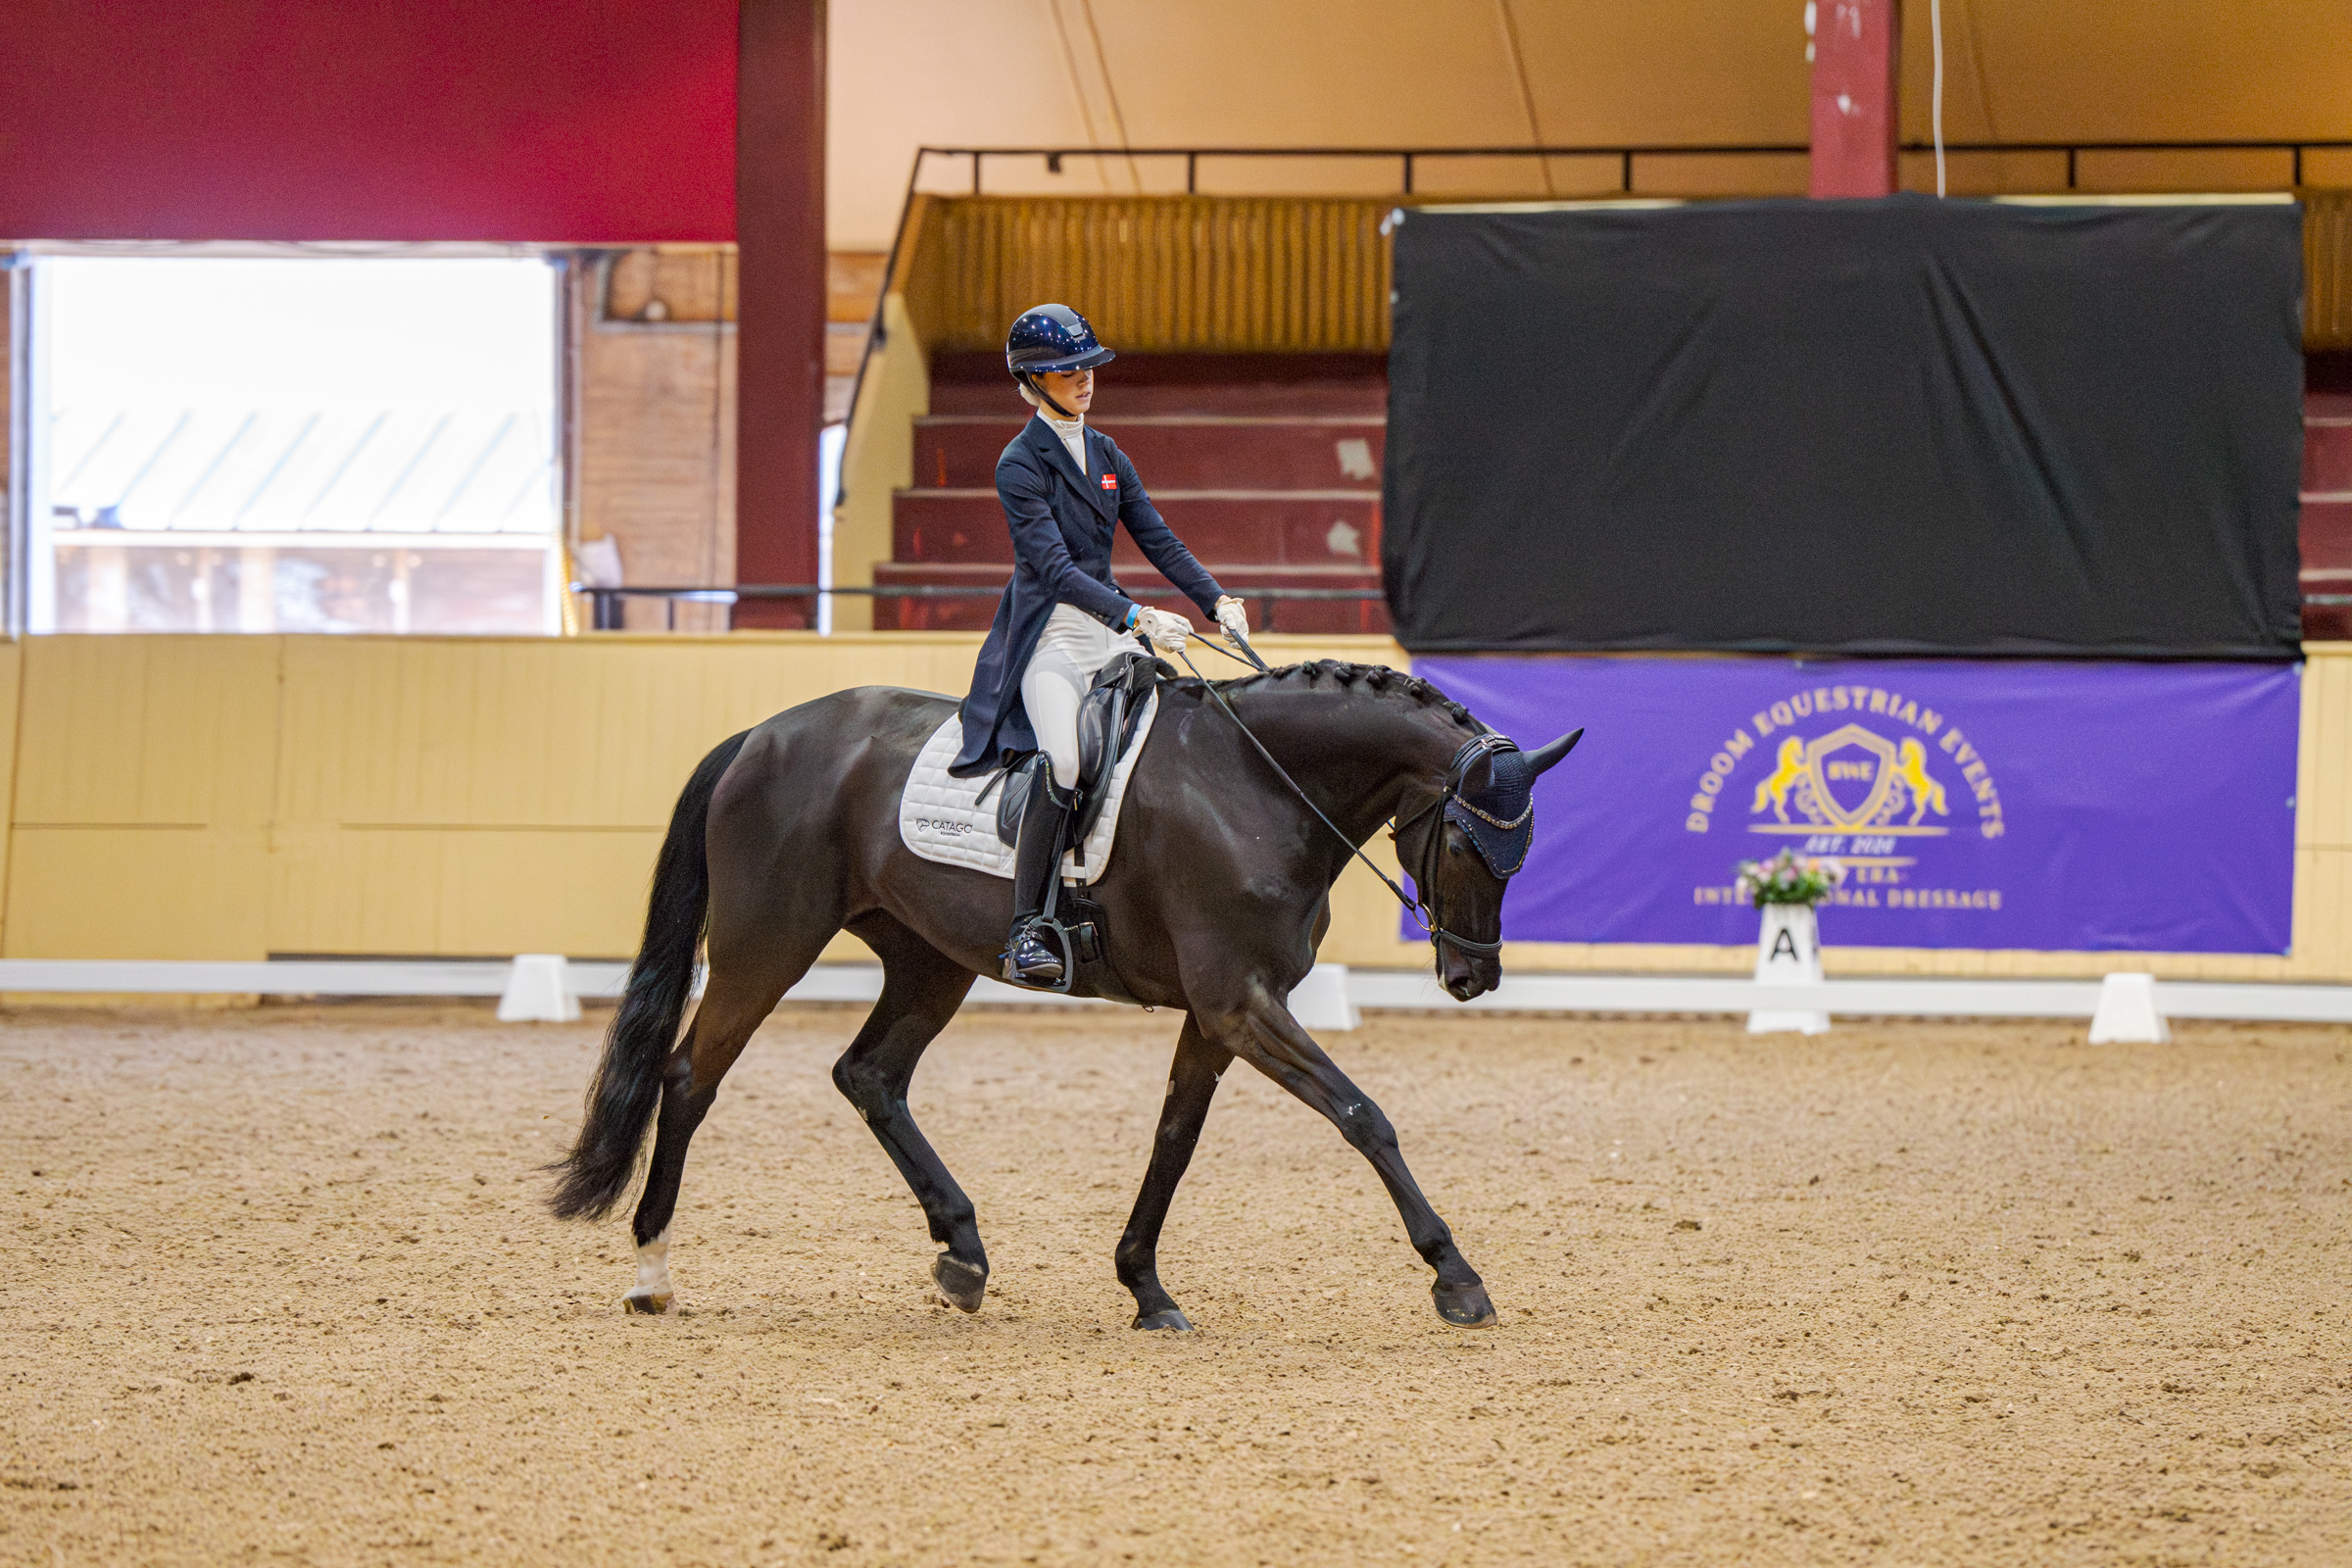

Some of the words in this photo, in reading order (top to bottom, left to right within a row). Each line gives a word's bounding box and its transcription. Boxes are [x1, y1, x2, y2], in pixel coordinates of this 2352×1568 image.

[1686, 729, 1754, 833] DROOM
[1752, 685, 1943, 737] EQUESTRIAN
[1938, 727, 2005, 839] EVENTS
[931, 819, 973, 834] CATAGO
[1886, 888, 2002, 911] DRESSAGE
[1770, 927, 1798, 962] A
